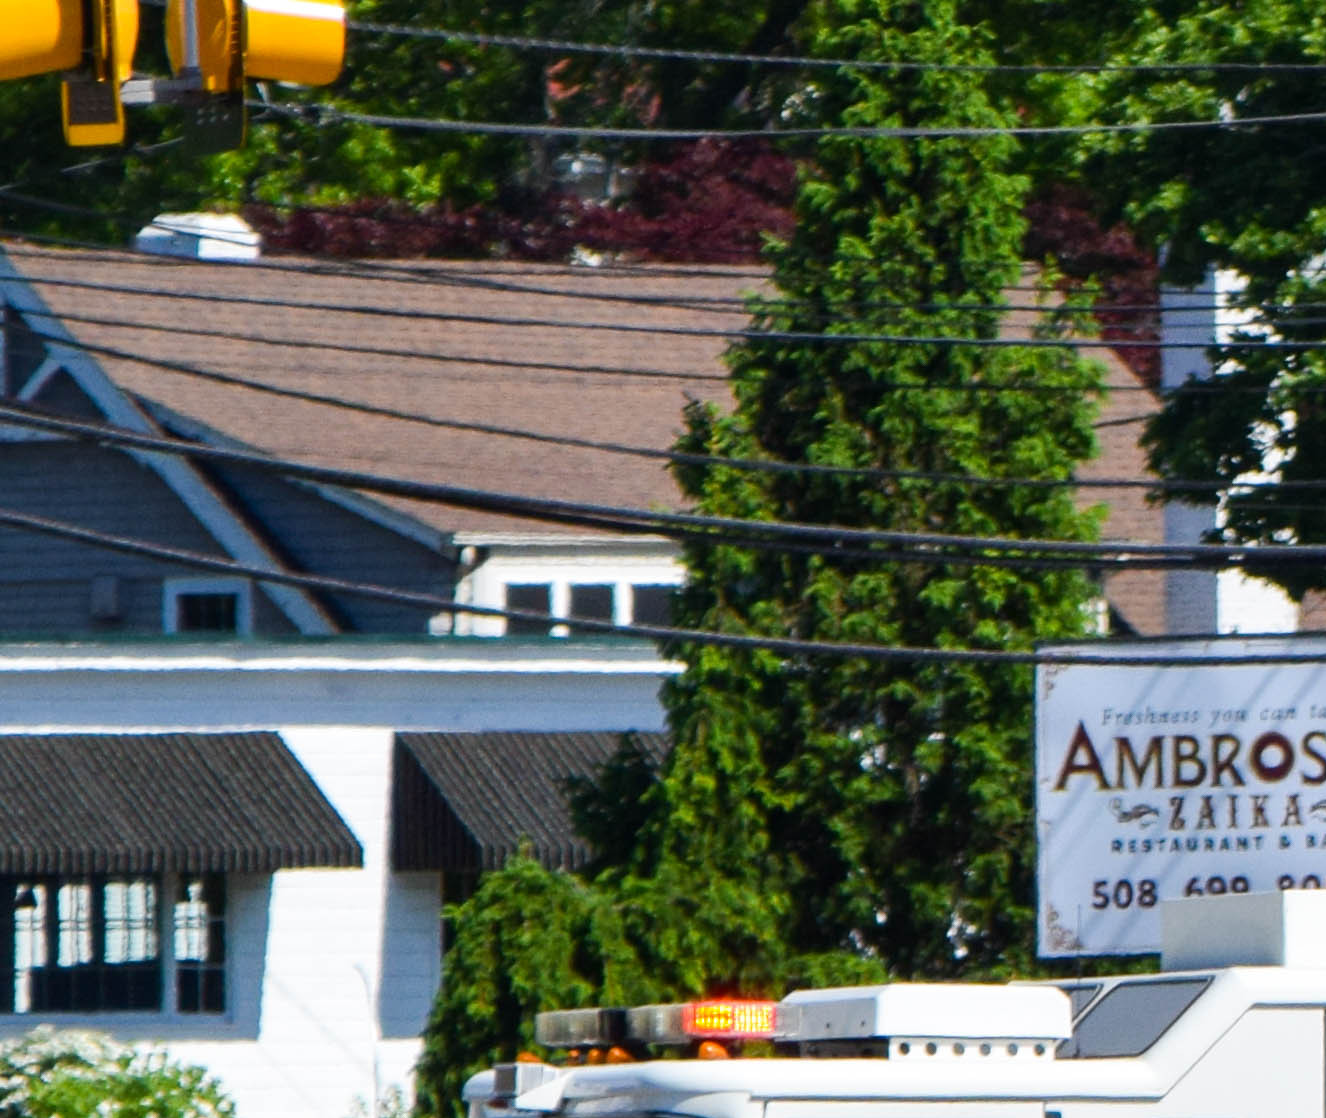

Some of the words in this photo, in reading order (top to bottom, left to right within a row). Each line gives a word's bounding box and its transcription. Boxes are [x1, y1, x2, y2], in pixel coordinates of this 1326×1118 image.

[1101, 706, 1199, 726] Freshness
[1210, 708, 1248, 728] you
[1259, 706, 1297, 721] can
[1169, 793, 1304, 830] ZAIKA
[1111, 835, 1265, 853] RESTAURANT
[1092, 879, 1158, 910] 508
